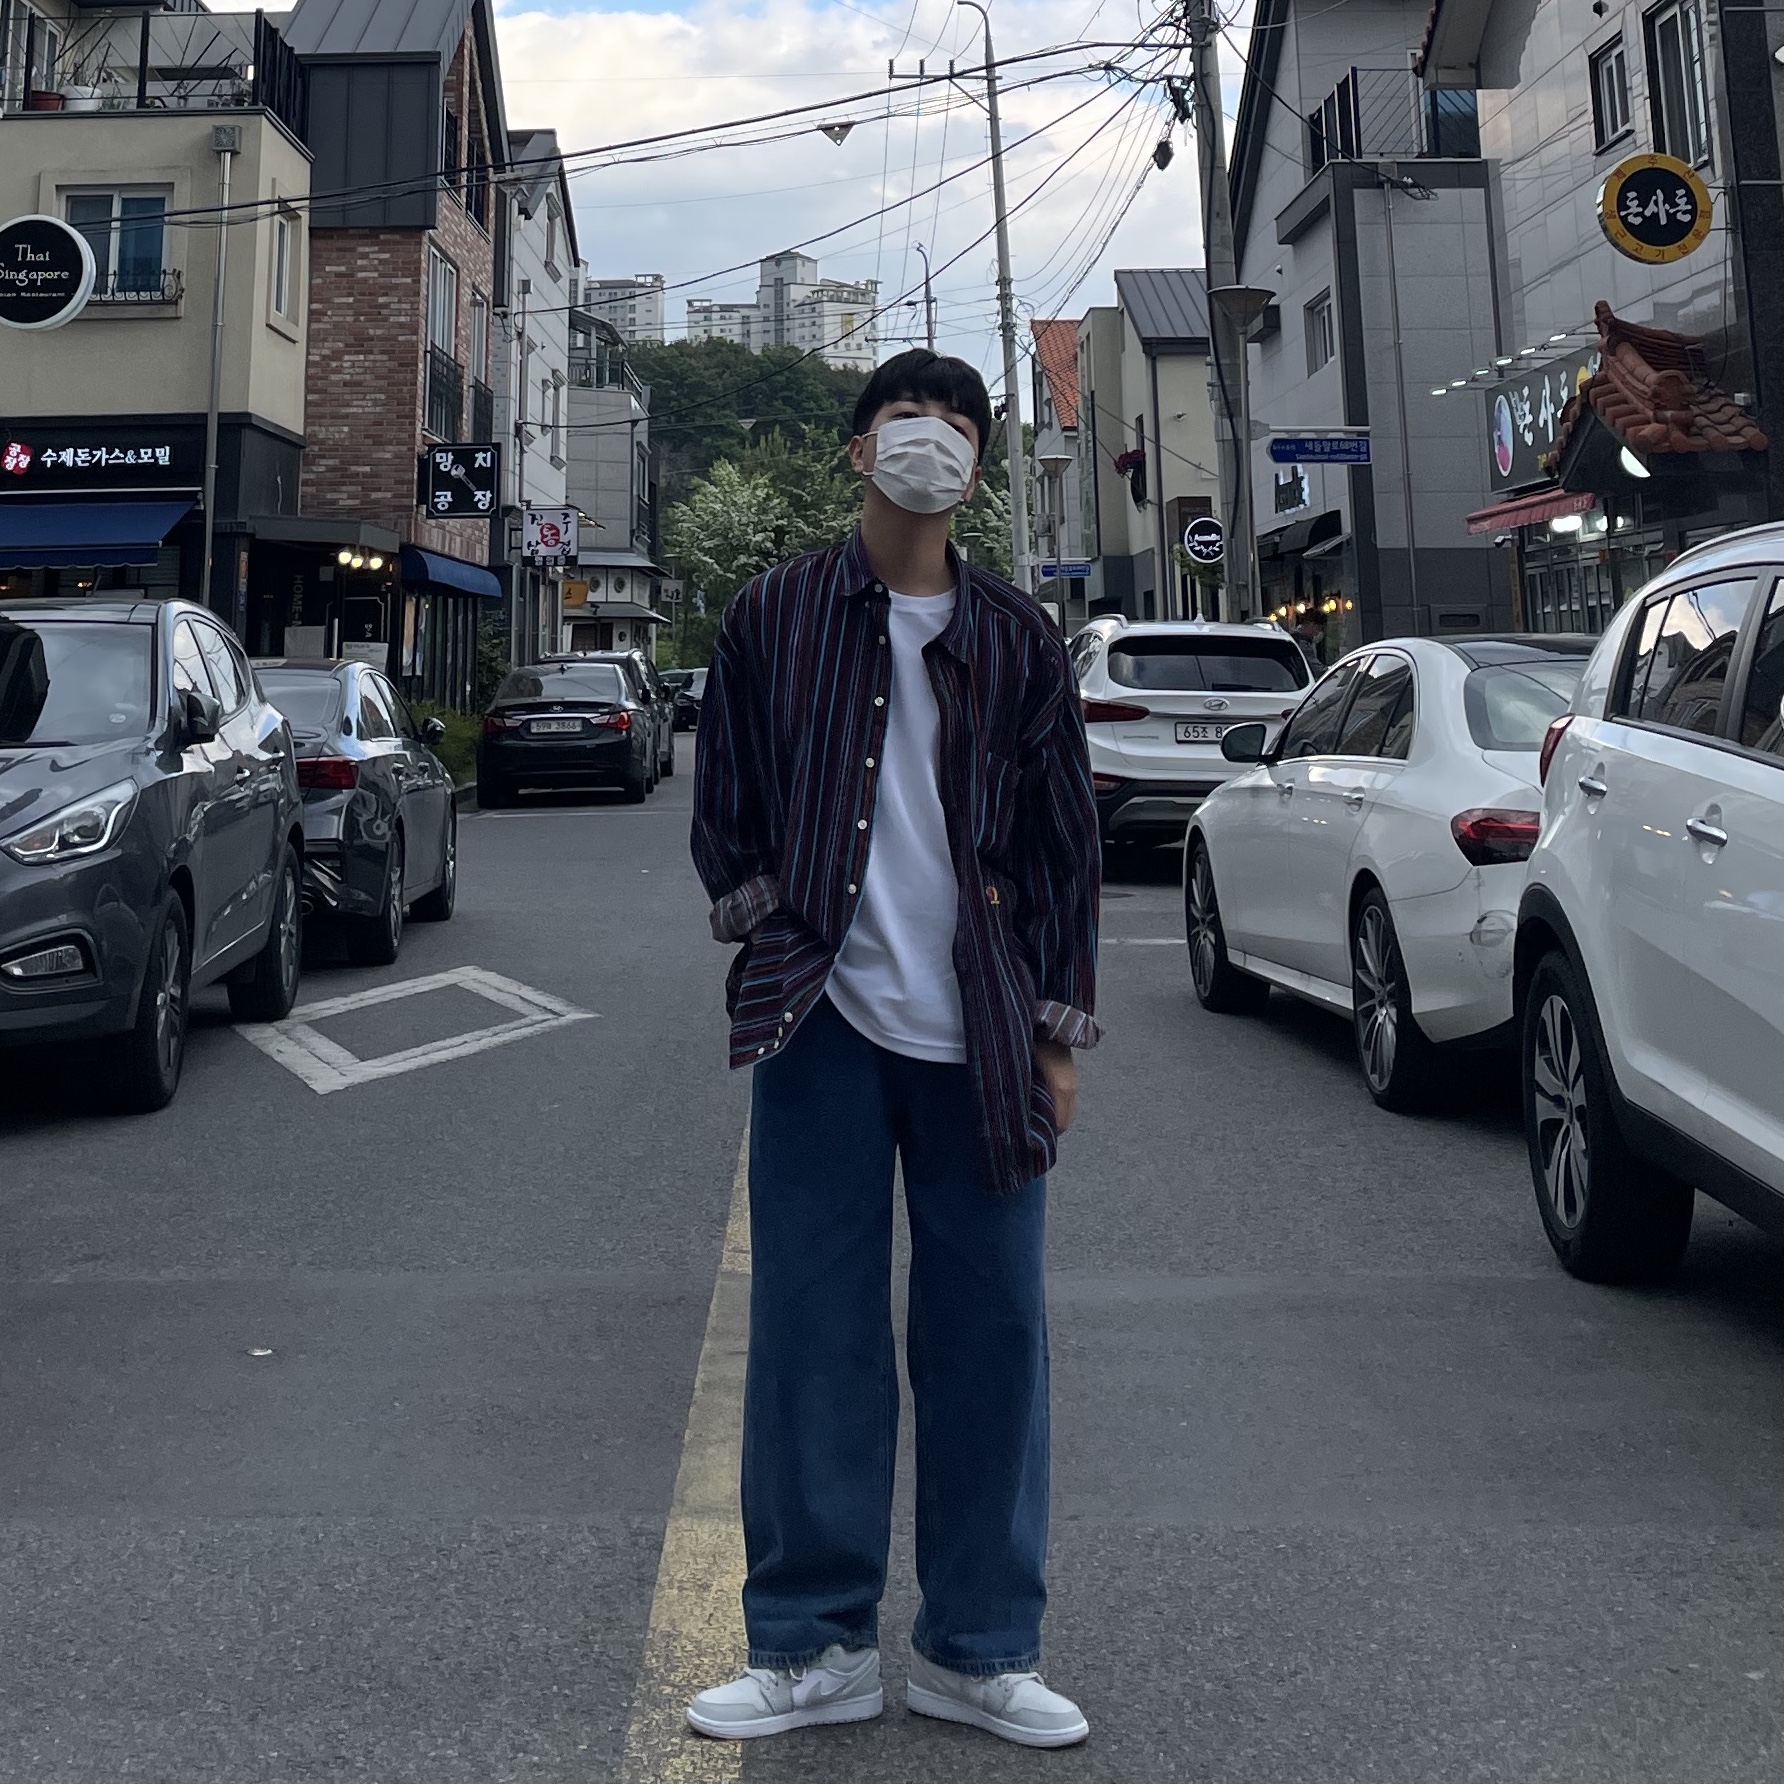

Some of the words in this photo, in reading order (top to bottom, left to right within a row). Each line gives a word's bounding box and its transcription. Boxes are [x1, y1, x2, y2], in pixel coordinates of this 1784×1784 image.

[1619, 188, 1692, 225] 돈사돈
[15, 244, 50, 261] Thai
[40, 446, 171, 468] 수제돈가스&모밀
[1183, 725, 1209, 739] 65조
